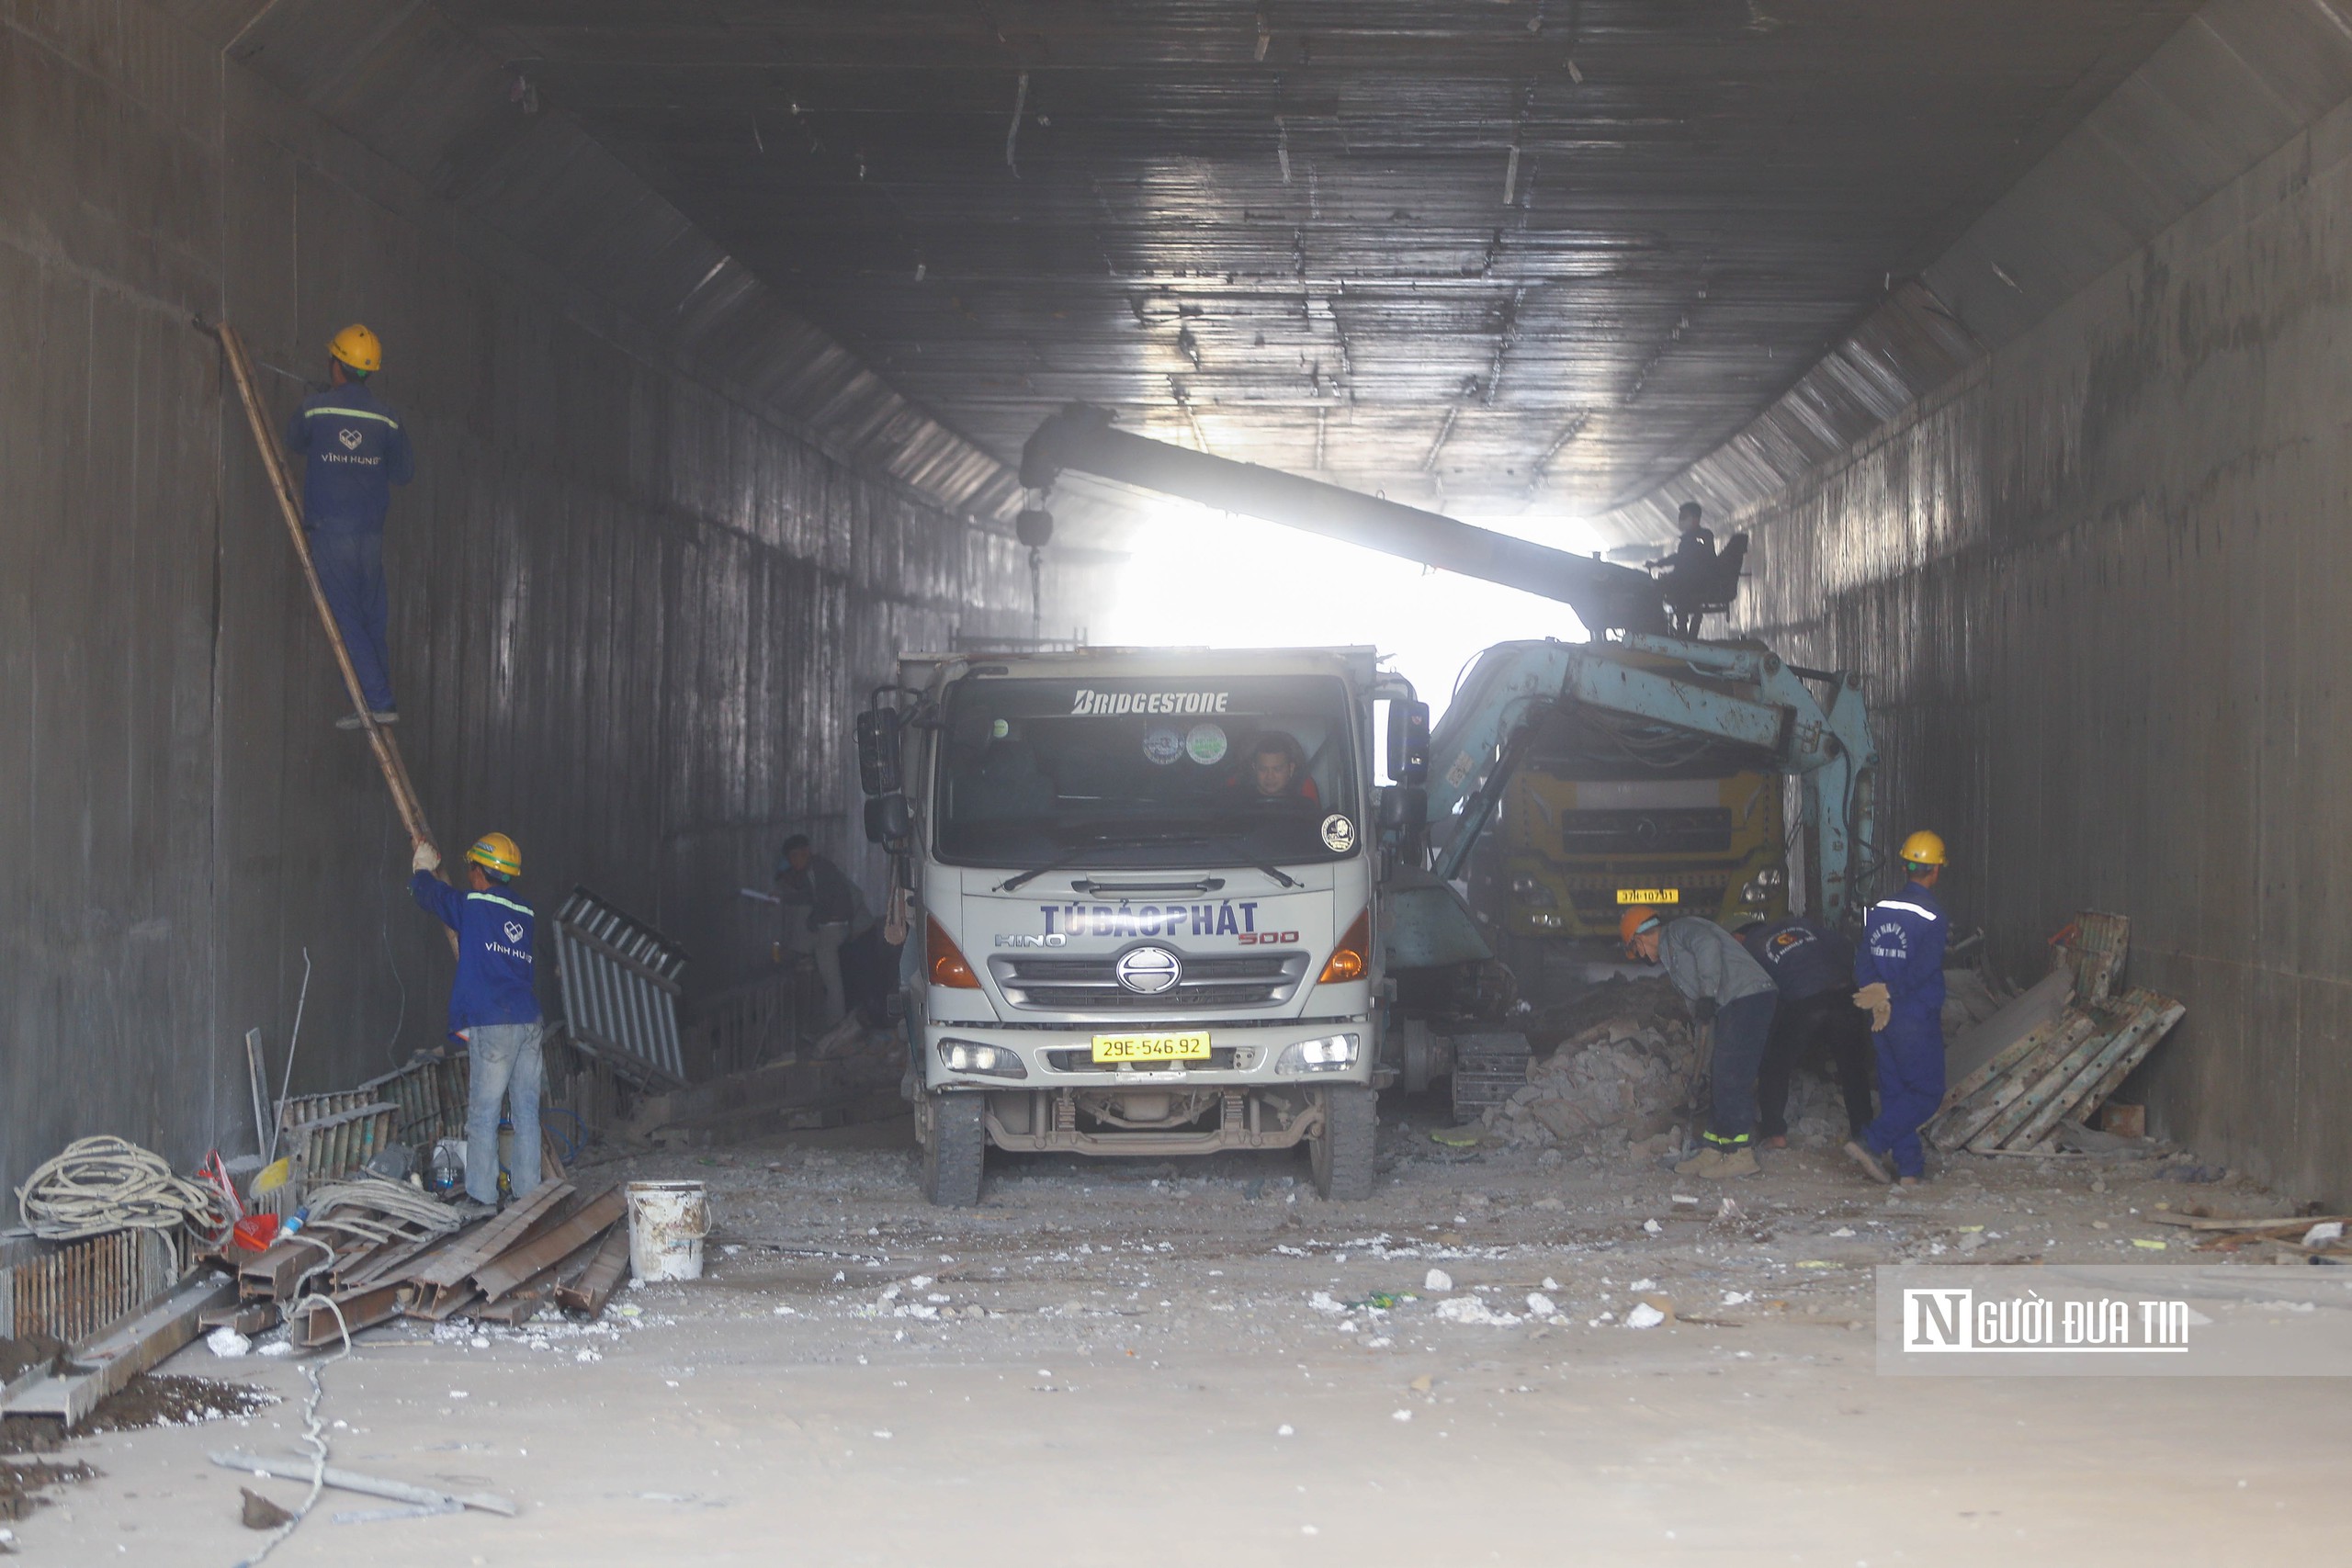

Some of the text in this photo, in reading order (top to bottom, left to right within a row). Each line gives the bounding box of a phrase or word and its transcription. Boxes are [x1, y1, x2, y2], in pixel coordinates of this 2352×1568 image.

[1071, 689, 1229, 715] BRIDGESTONE
[994, 932, 1068, 948] HINO
[1238, 931, 1300, 945] 500
[1103, 1038, 1200, 1056] 29E-546.92
